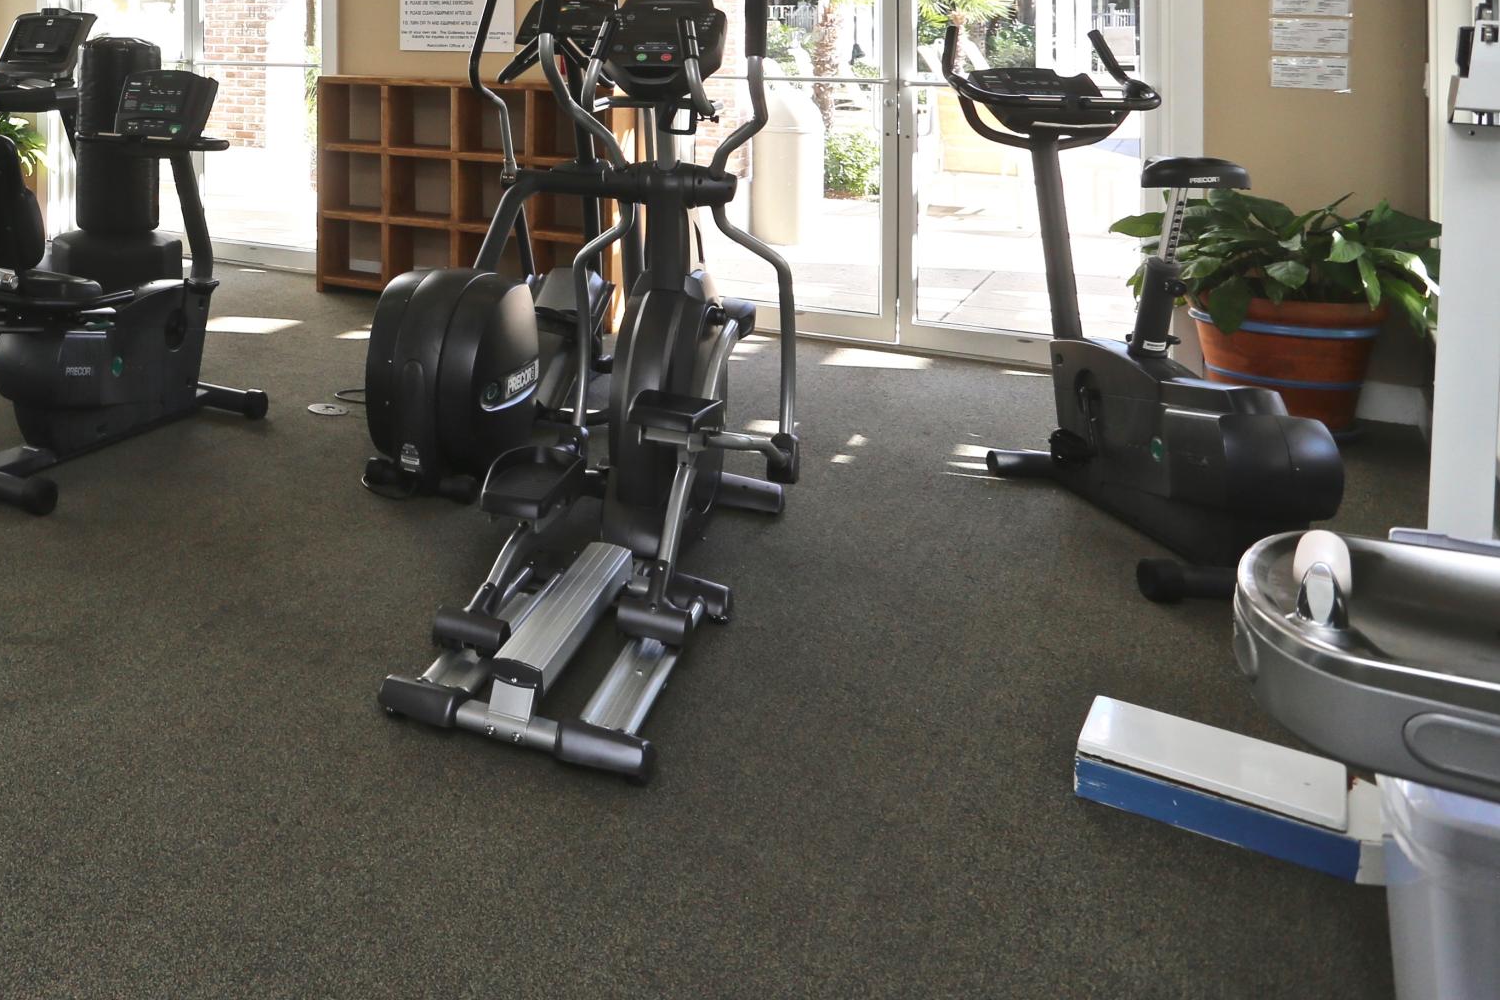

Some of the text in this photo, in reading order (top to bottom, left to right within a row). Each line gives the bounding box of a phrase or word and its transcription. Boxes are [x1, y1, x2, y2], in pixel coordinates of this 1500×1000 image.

[1189, 176, 1220, 184] PRECOR
[65, 366, 92, 376] PRECOR
[507, 367, 532, 395] PRECOR
